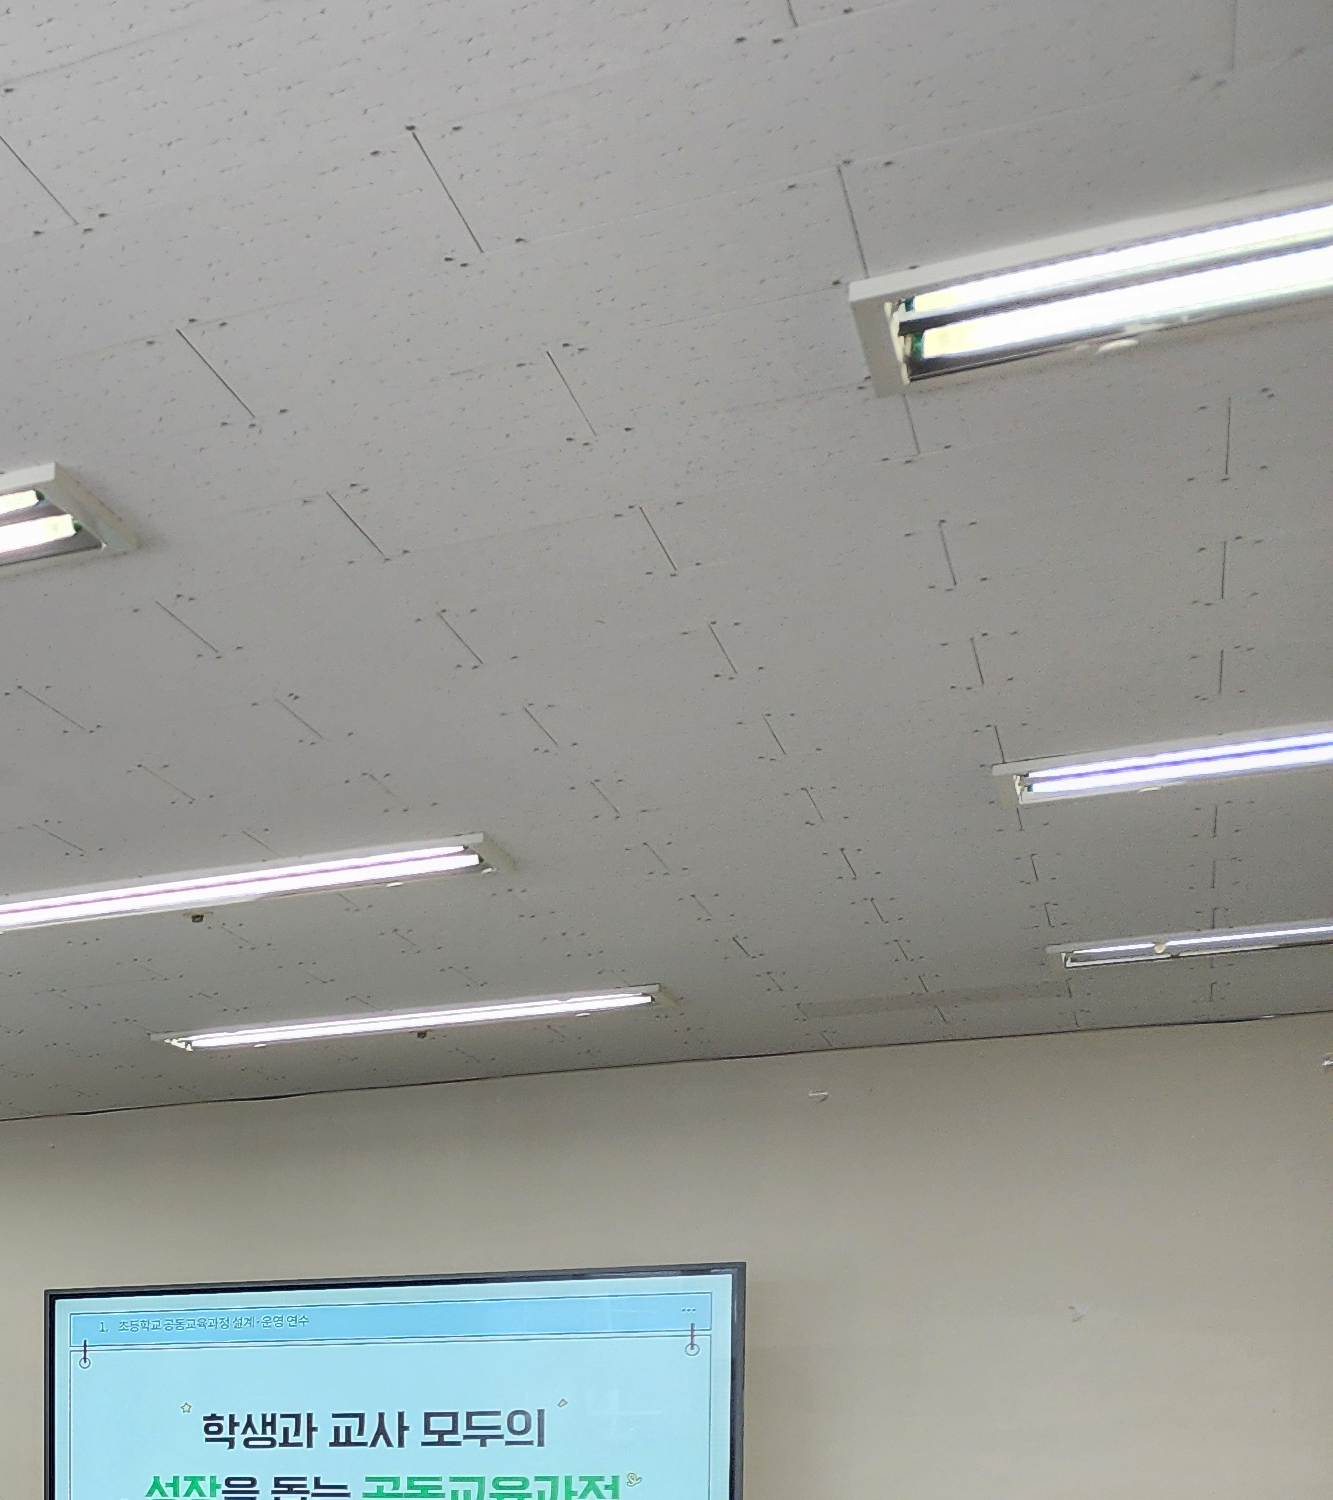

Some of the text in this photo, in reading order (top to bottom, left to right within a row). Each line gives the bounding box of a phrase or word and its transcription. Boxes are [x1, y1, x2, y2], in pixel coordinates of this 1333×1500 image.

[99, 1321, 109, 1333] 1.
[119, 1319, 161, 1333] 초등학교
[164, 1316, 230, 1331] 공동교육과정
[287, 1314, 309, 1328] 연수
[202, 1408, 545, 1450] 학생과 교사 모두의
